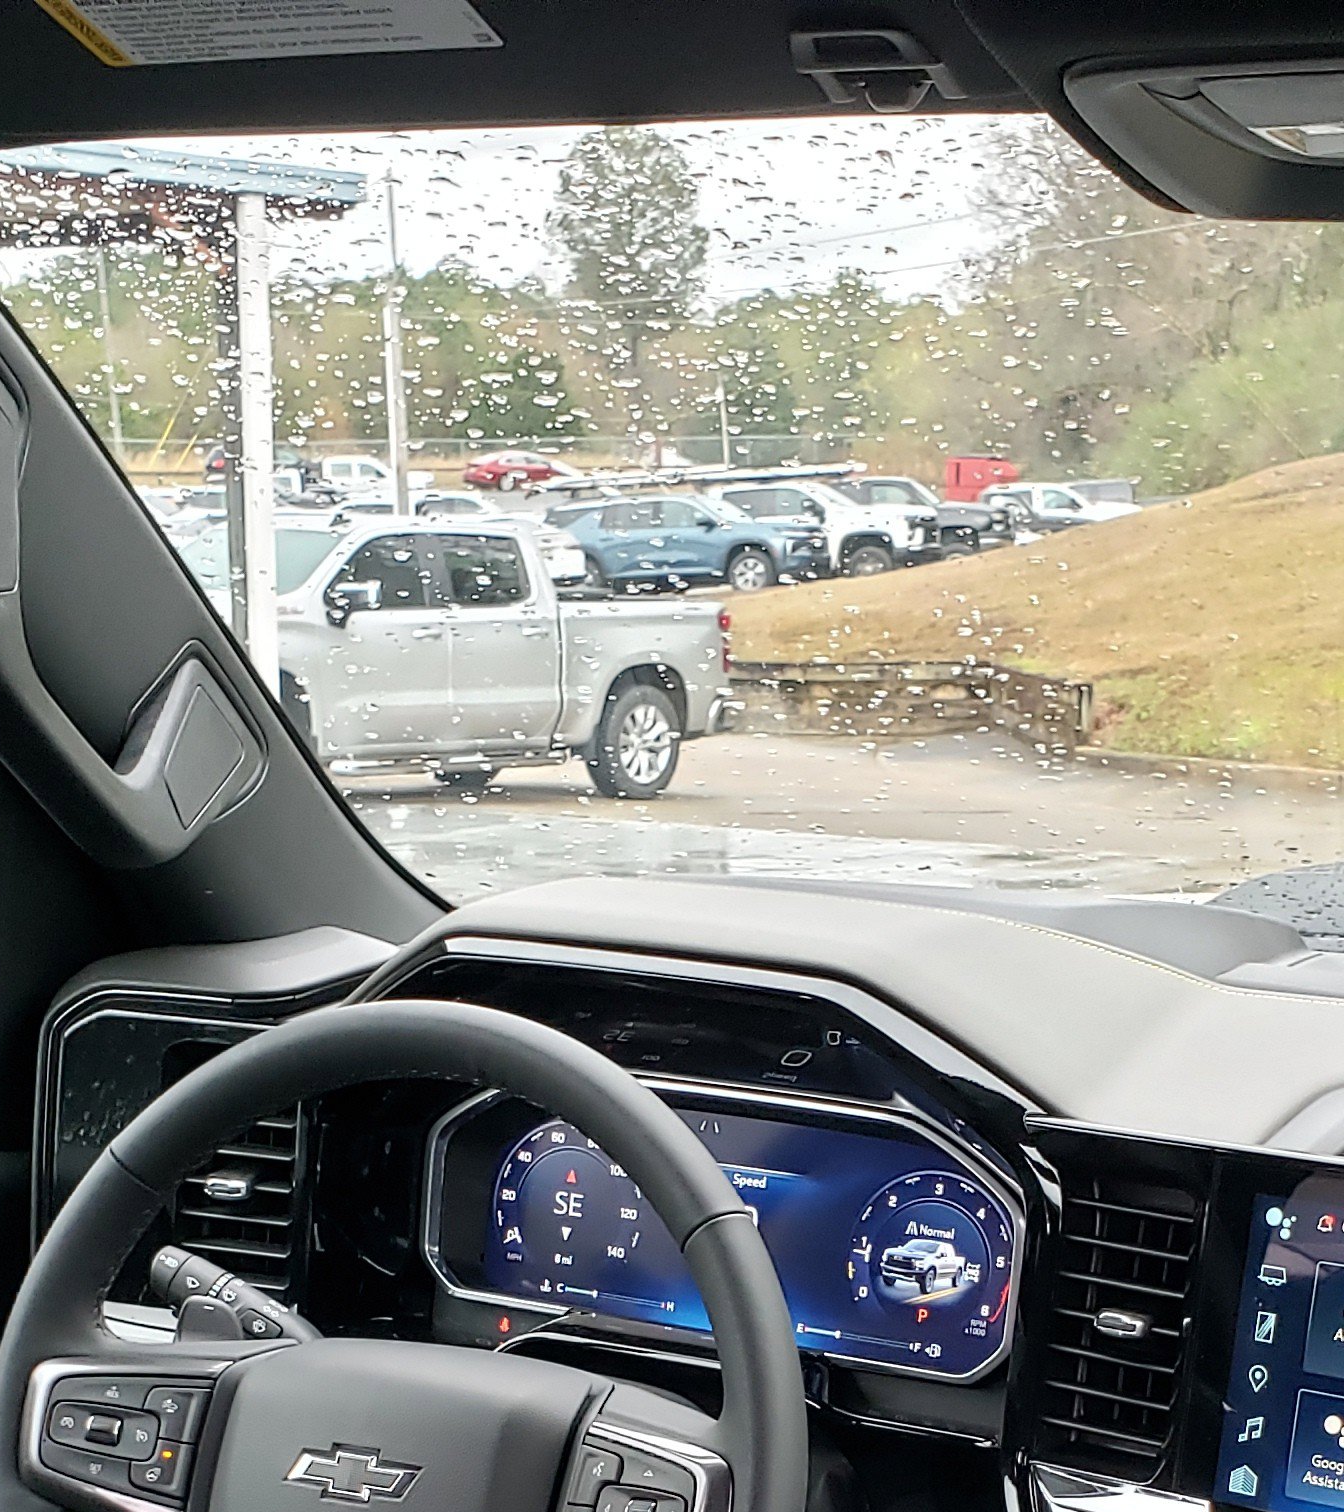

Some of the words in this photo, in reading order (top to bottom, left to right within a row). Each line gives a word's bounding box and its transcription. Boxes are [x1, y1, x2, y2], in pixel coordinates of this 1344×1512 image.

[551, 1132, 565, 1143] 60
[517, 1151, 532, 1163] 40
[732, 1173, 767, 1189] Speed
[502, 1189, 516, 1200] 20
[934, 1184, 945, 1195] 3
[553, 1191, 584, 1218] SE
[888, 1196, 898, 1208] 2
[620, 1207, 638, 1220] 120
[976, 1208, 986, 1220] 4
[919, 1224, 955, 1240] Normal
[861, 1236, 868, 1247] 1
[607, 1245, 625, 1259] 140
[996, 1256, 1005, 1268] 5
[556, 1282, 565, 1293] C
[858, 1286, 868, 1298] 0
[666, 1301, 675, 1312] H
[918, 1309, 928, 1323] P
[796, 1322, 805, 1333] E
[970, 1319, 987, 1328] RPM
[913, 1342, 922, 1352] F
